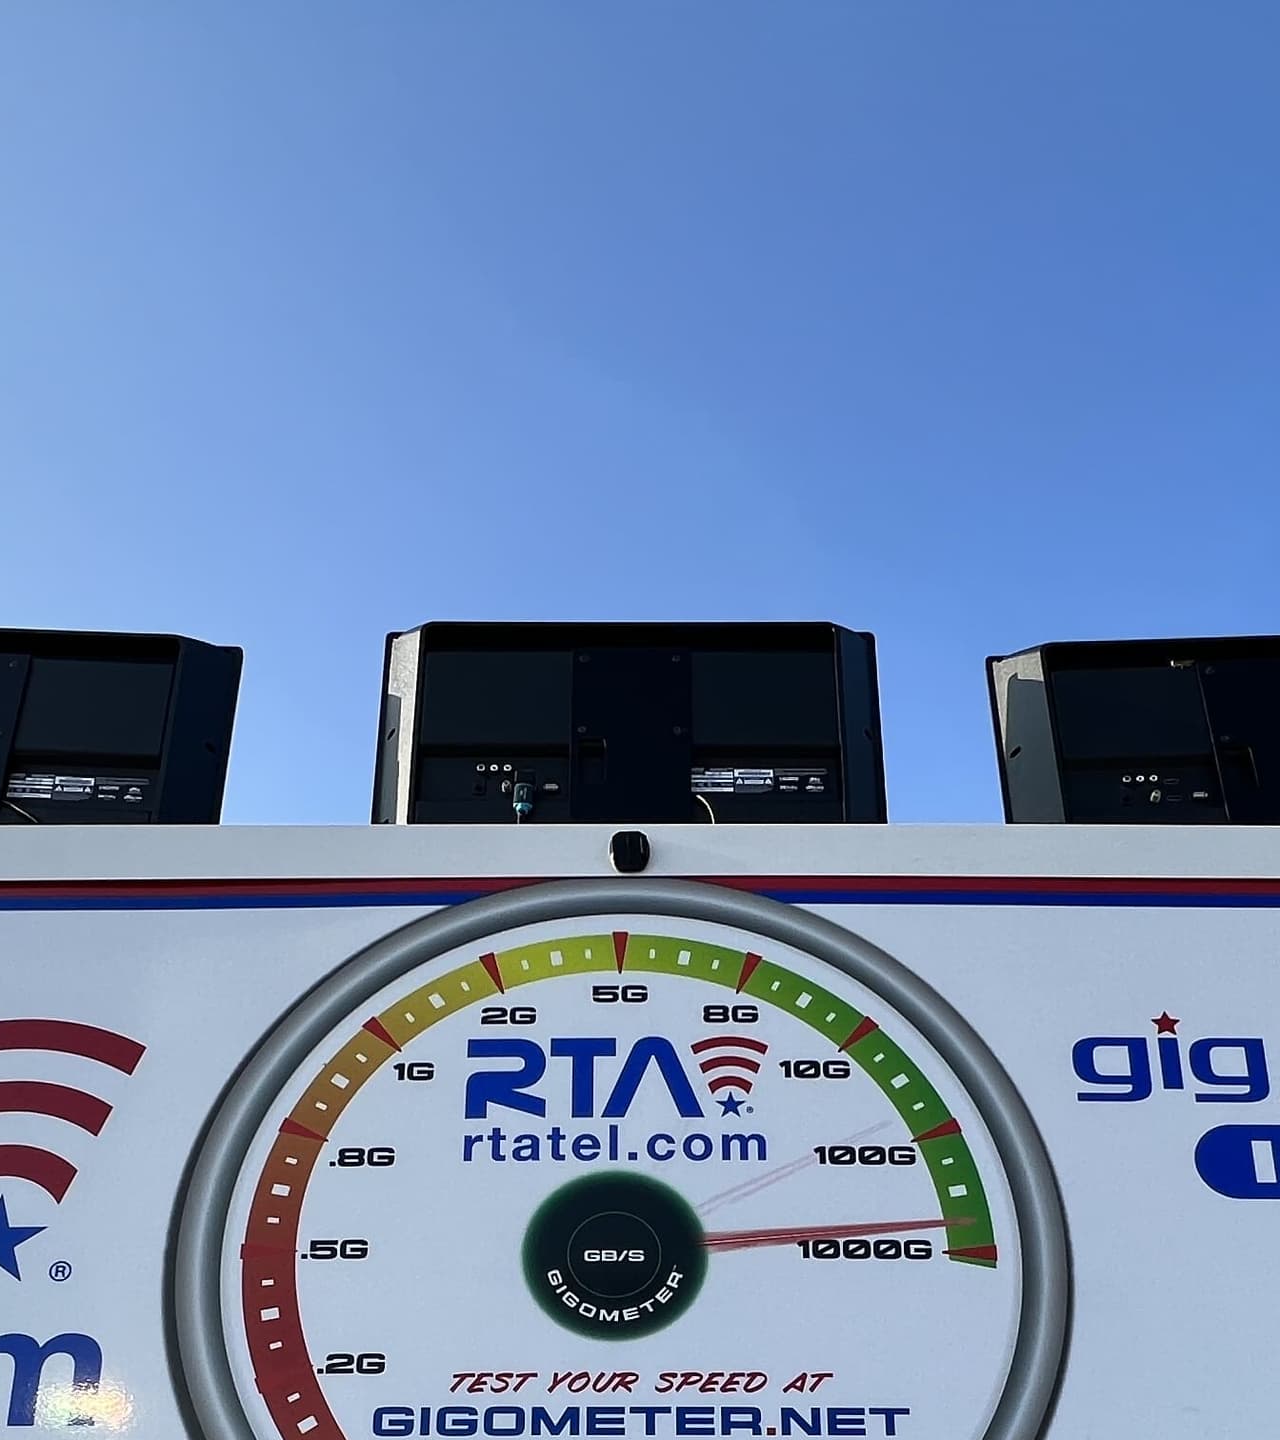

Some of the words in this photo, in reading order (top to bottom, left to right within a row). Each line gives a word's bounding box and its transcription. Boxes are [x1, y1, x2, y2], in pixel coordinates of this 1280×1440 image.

[591, 984, 649, 1004] 5G
[480, 1006, 537, 1025] 2G
[703, 1005, 759, 1024] 8G
[393, 1063, 435, 1081] 1G
[464, 1036, 705, 1119] RTA
[778, 1060, 851, 1079] 10G
[463, 1124, 767, 1161] rtatel.com
[328, 1147, 396, 1167] .8G
[813, 1145, 916, 1166] 100G
[301, 1239, 369, 1260] .5G
[583, 1249, 645, 1262] GB/S
[797, 1239, 933, 1260] 1000G
[547, 1269, 683, 1322] GIGOMETER
[316, 1353, 386, 1374] .2G
[449, 1371, 538, 1394] TEST
[546, 1372, 640, 1394] YOUR
[654, 1371, 768, 1394] SPEED
[782, 1371, 834, 1394] AT
[372, 1405, 911, 1437] GIGOMETER.NET
